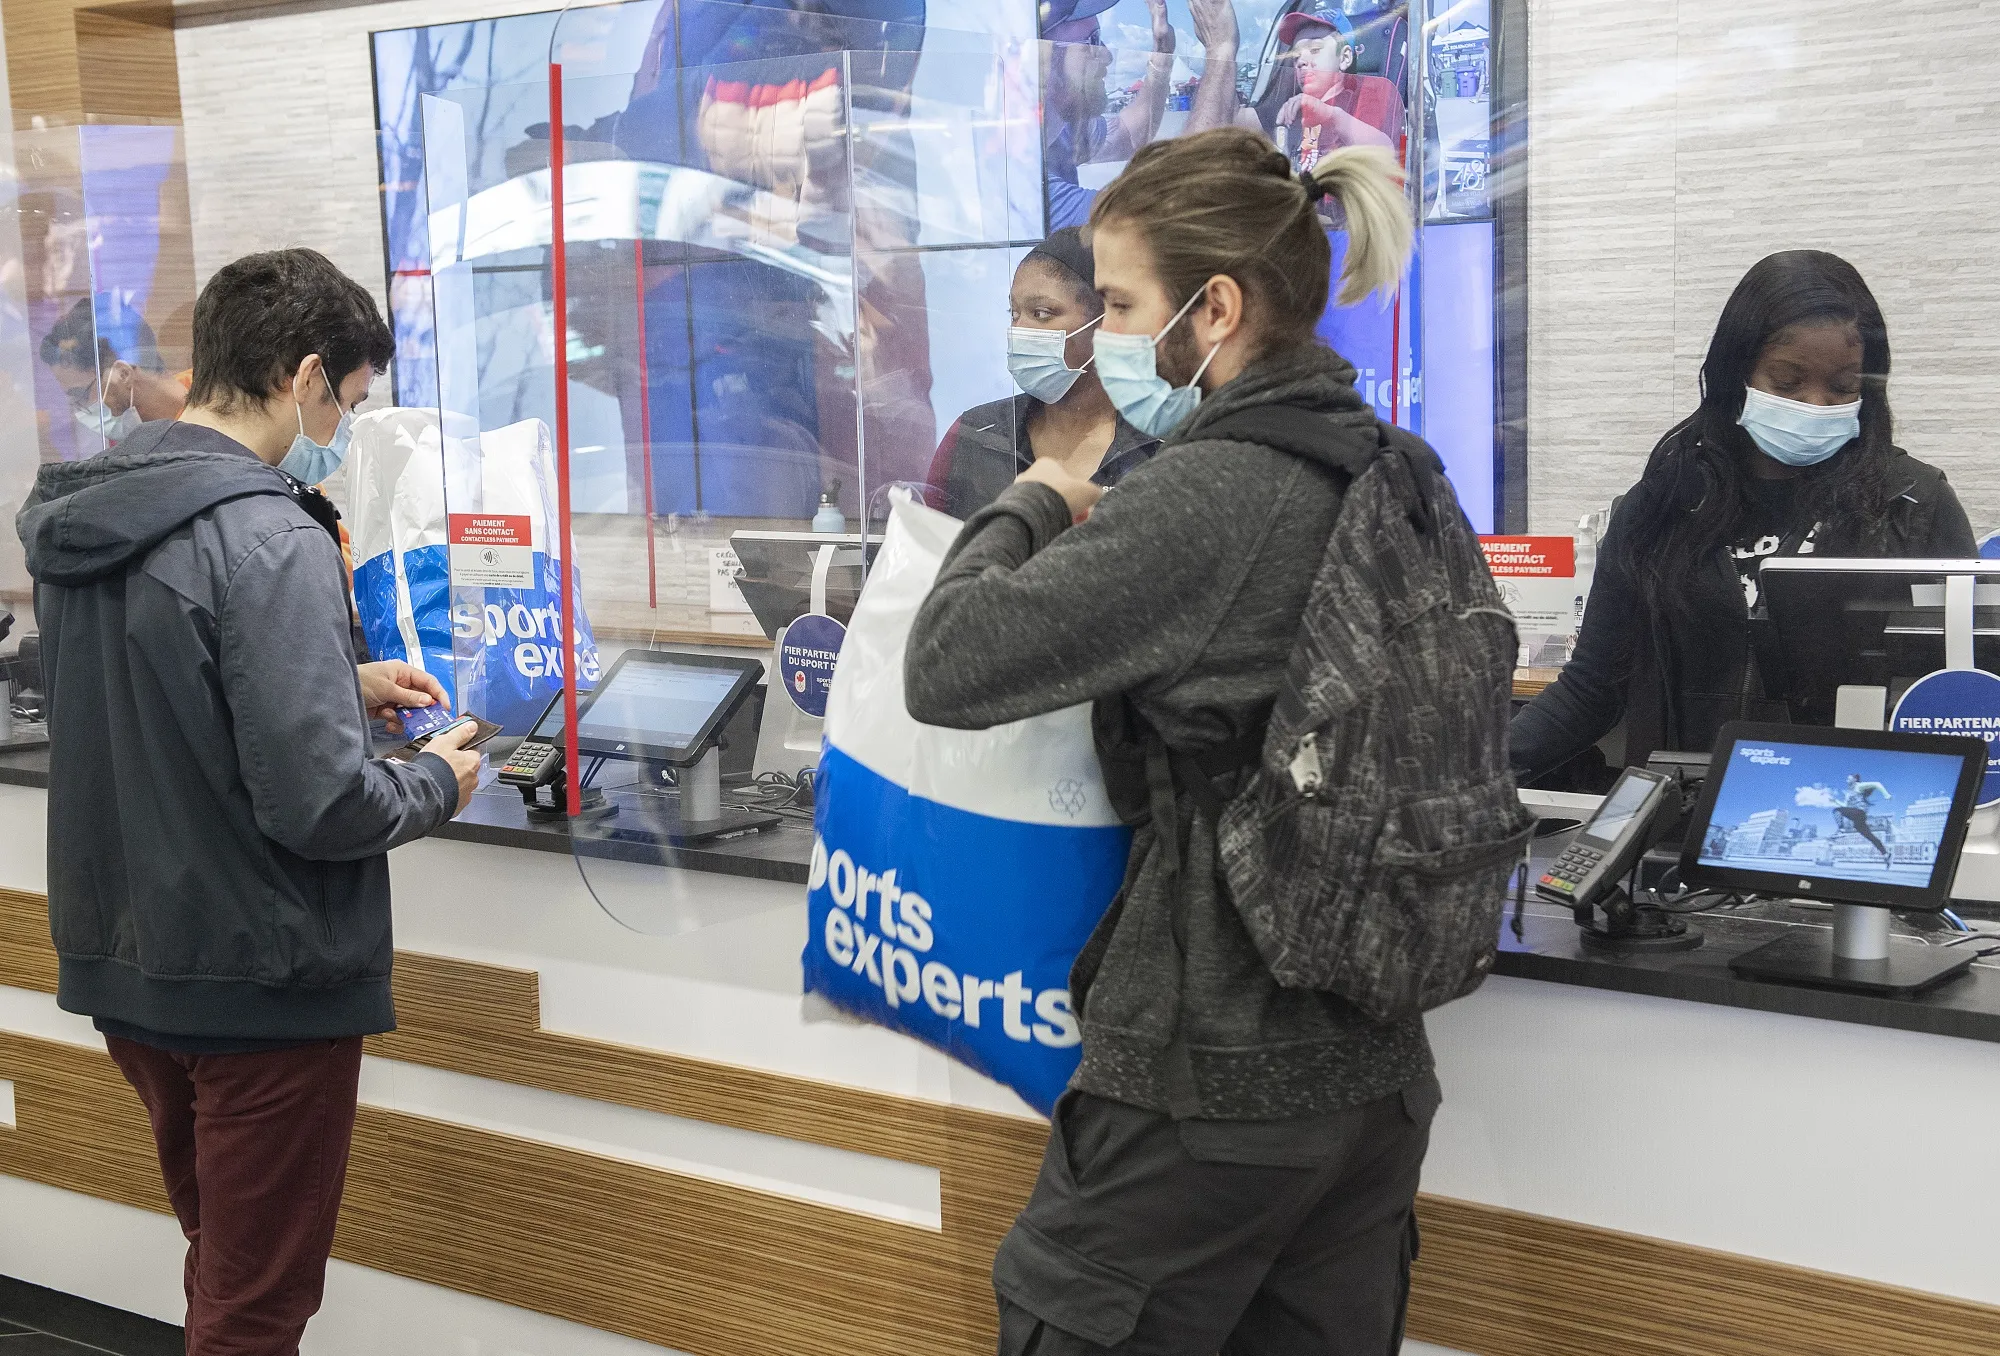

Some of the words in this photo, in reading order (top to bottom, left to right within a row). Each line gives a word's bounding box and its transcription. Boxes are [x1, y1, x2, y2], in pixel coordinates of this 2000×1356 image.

[472, 519, 505, 528] PAIEMENT
[483, 528, 514, 536] CONTACT
[1493, 554, 1546, 564] CONTACT
[1514, 566, 1553, 574] PAYMENT
[784, 646, 801, 656] FIER
[788, 657, 800, 666] DU
[801, 659, 829, 671] SPORT
[1900, 717, 1932, 729] FIER
[1740, 748, 1775, 757] sports
[1750, 755, 1791, 765] experts
[825, 907, 1082, 1048] experts
